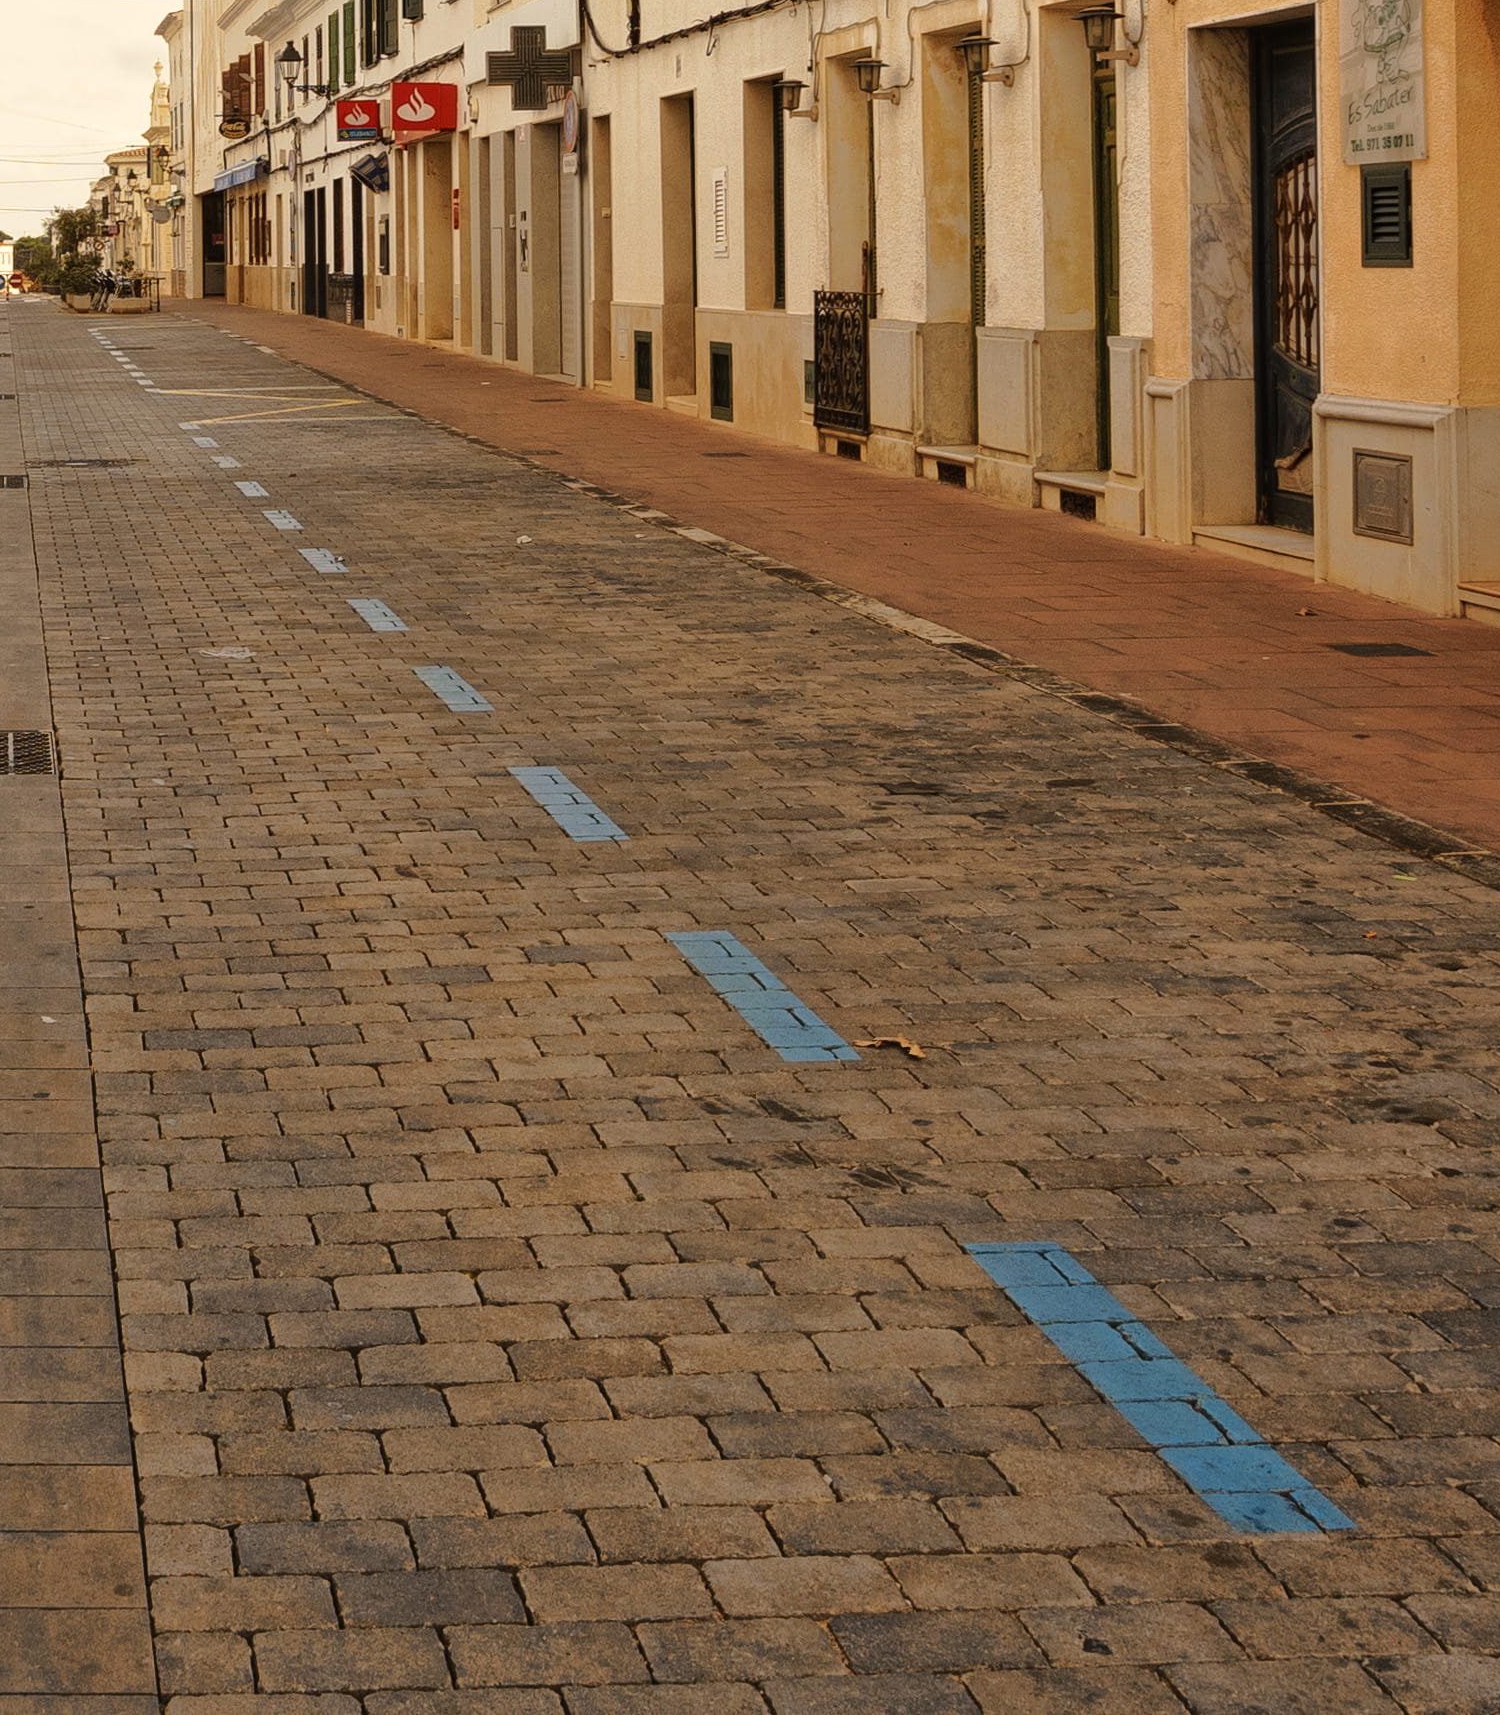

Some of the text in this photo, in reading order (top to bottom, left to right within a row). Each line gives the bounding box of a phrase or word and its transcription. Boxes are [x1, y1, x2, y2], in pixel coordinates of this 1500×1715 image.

[1348, 86, 1414, 124] Es Sabater
[1366, 137, 1380, 151] 971
[1405, 133, 1414, 147] 11
